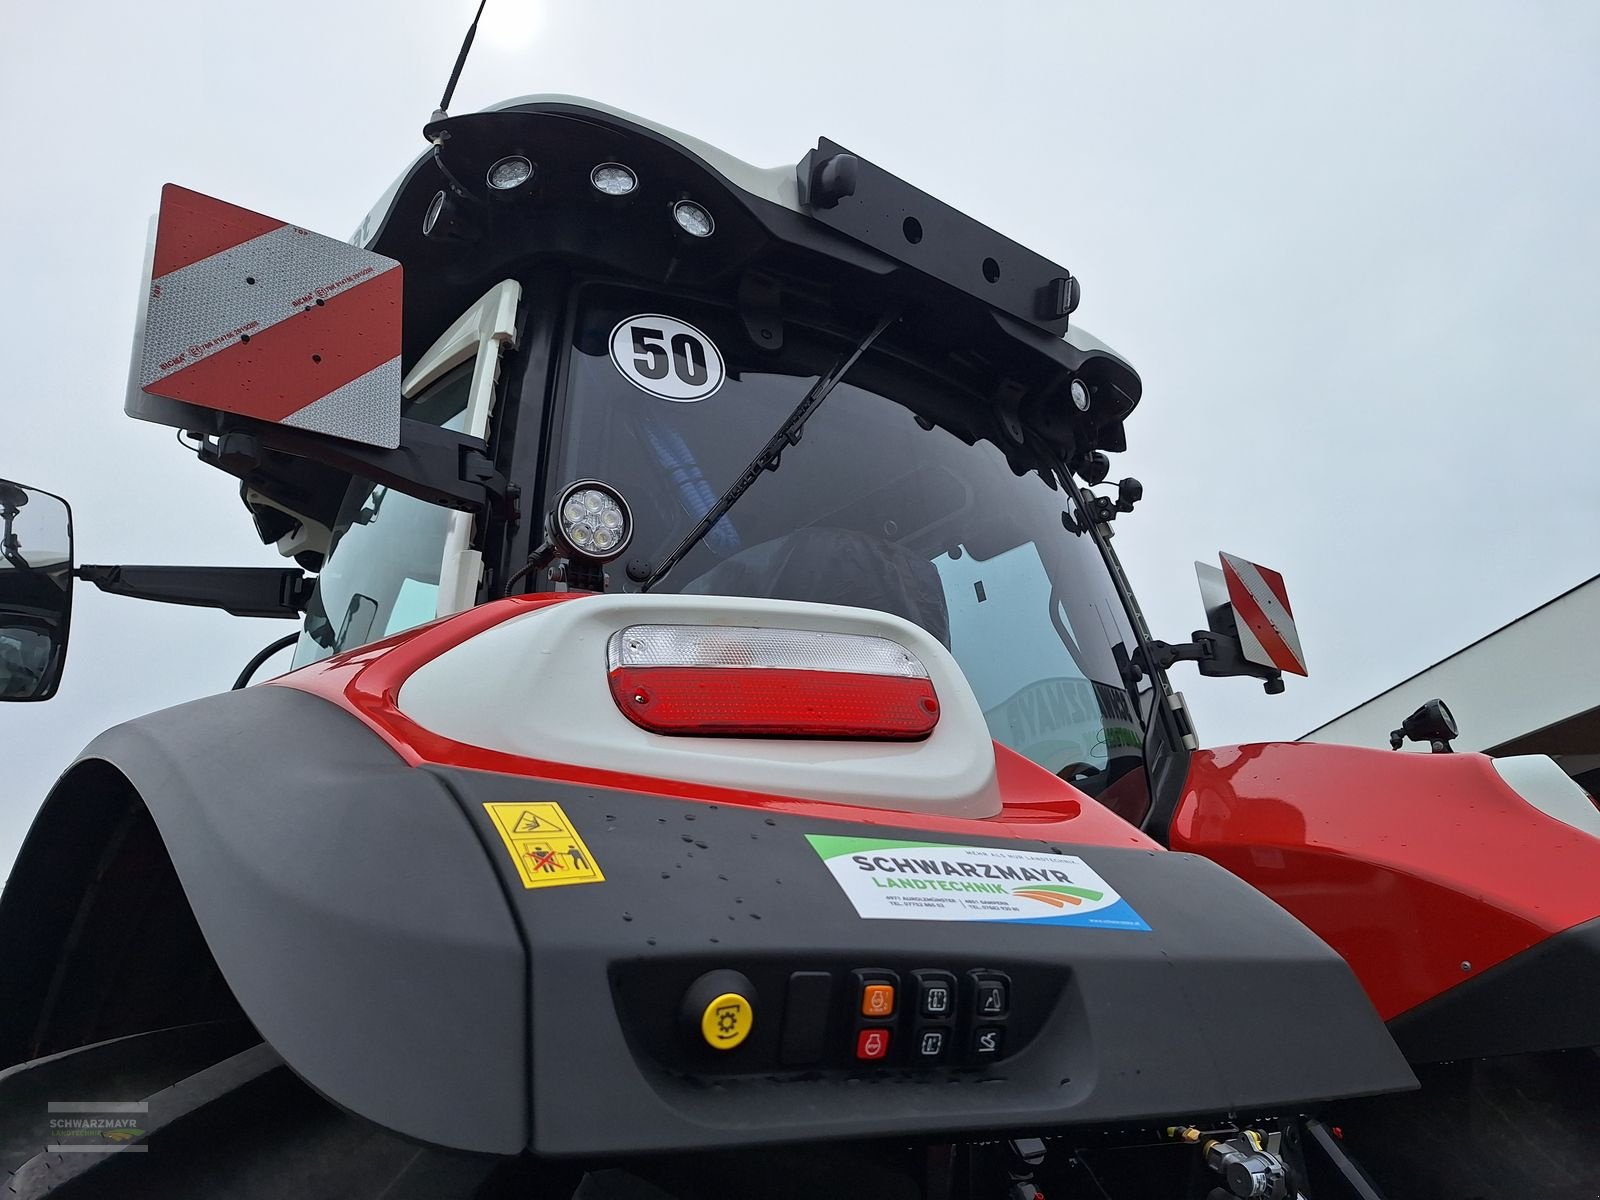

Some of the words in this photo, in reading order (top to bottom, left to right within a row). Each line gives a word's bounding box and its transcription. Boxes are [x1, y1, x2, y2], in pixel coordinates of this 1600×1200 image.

[293, 228, 308, 236] TOP
[631, 326, 708, 386] 50
[852, 856, 1074, 884] SCHWARZMAYR
[872, 876, 1009, 894] LANDTECHNIK
